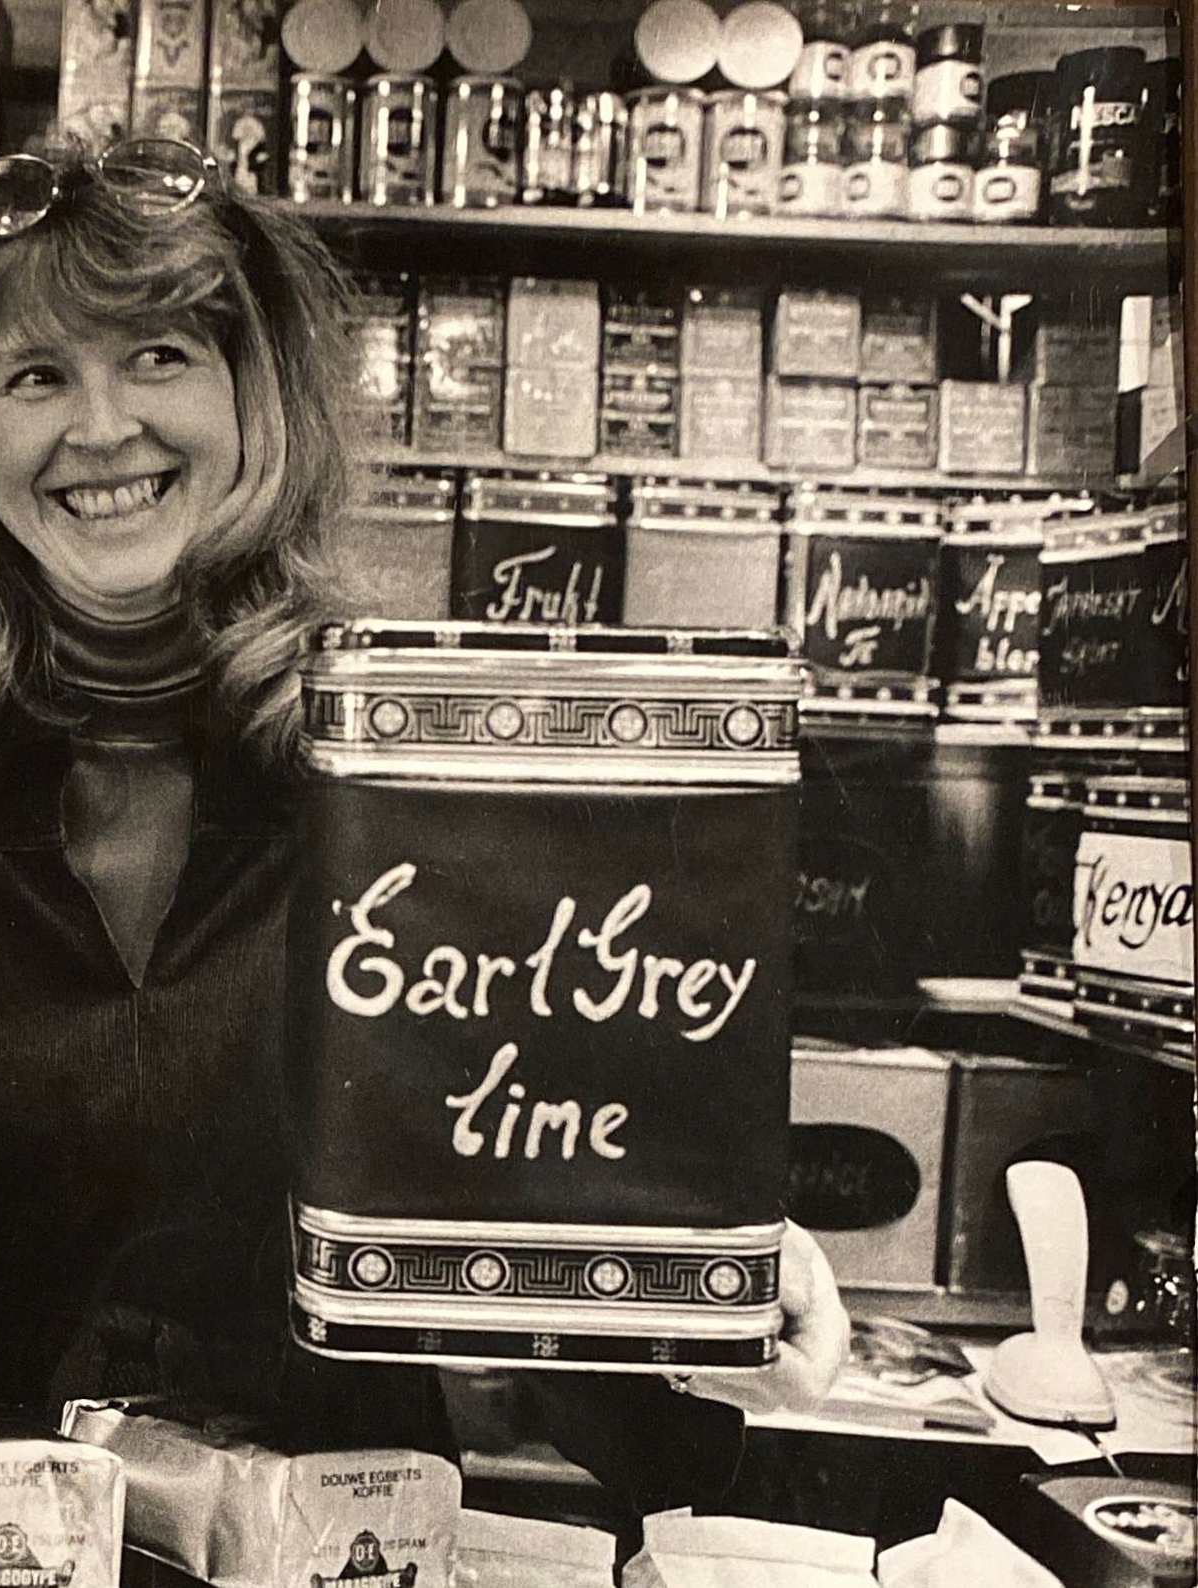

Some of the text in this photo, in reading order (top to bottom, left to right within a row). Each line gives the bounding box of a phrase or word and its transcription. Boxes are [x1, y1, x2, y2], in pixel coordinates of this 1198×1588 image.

[1075, 852, 1193, 950] Kenya
[325, 862, 757, 1042] Earl Grey
[320, 1471, 367, 1488] DOUWE
[352, 1485, 395, 1500] KOFFIE
